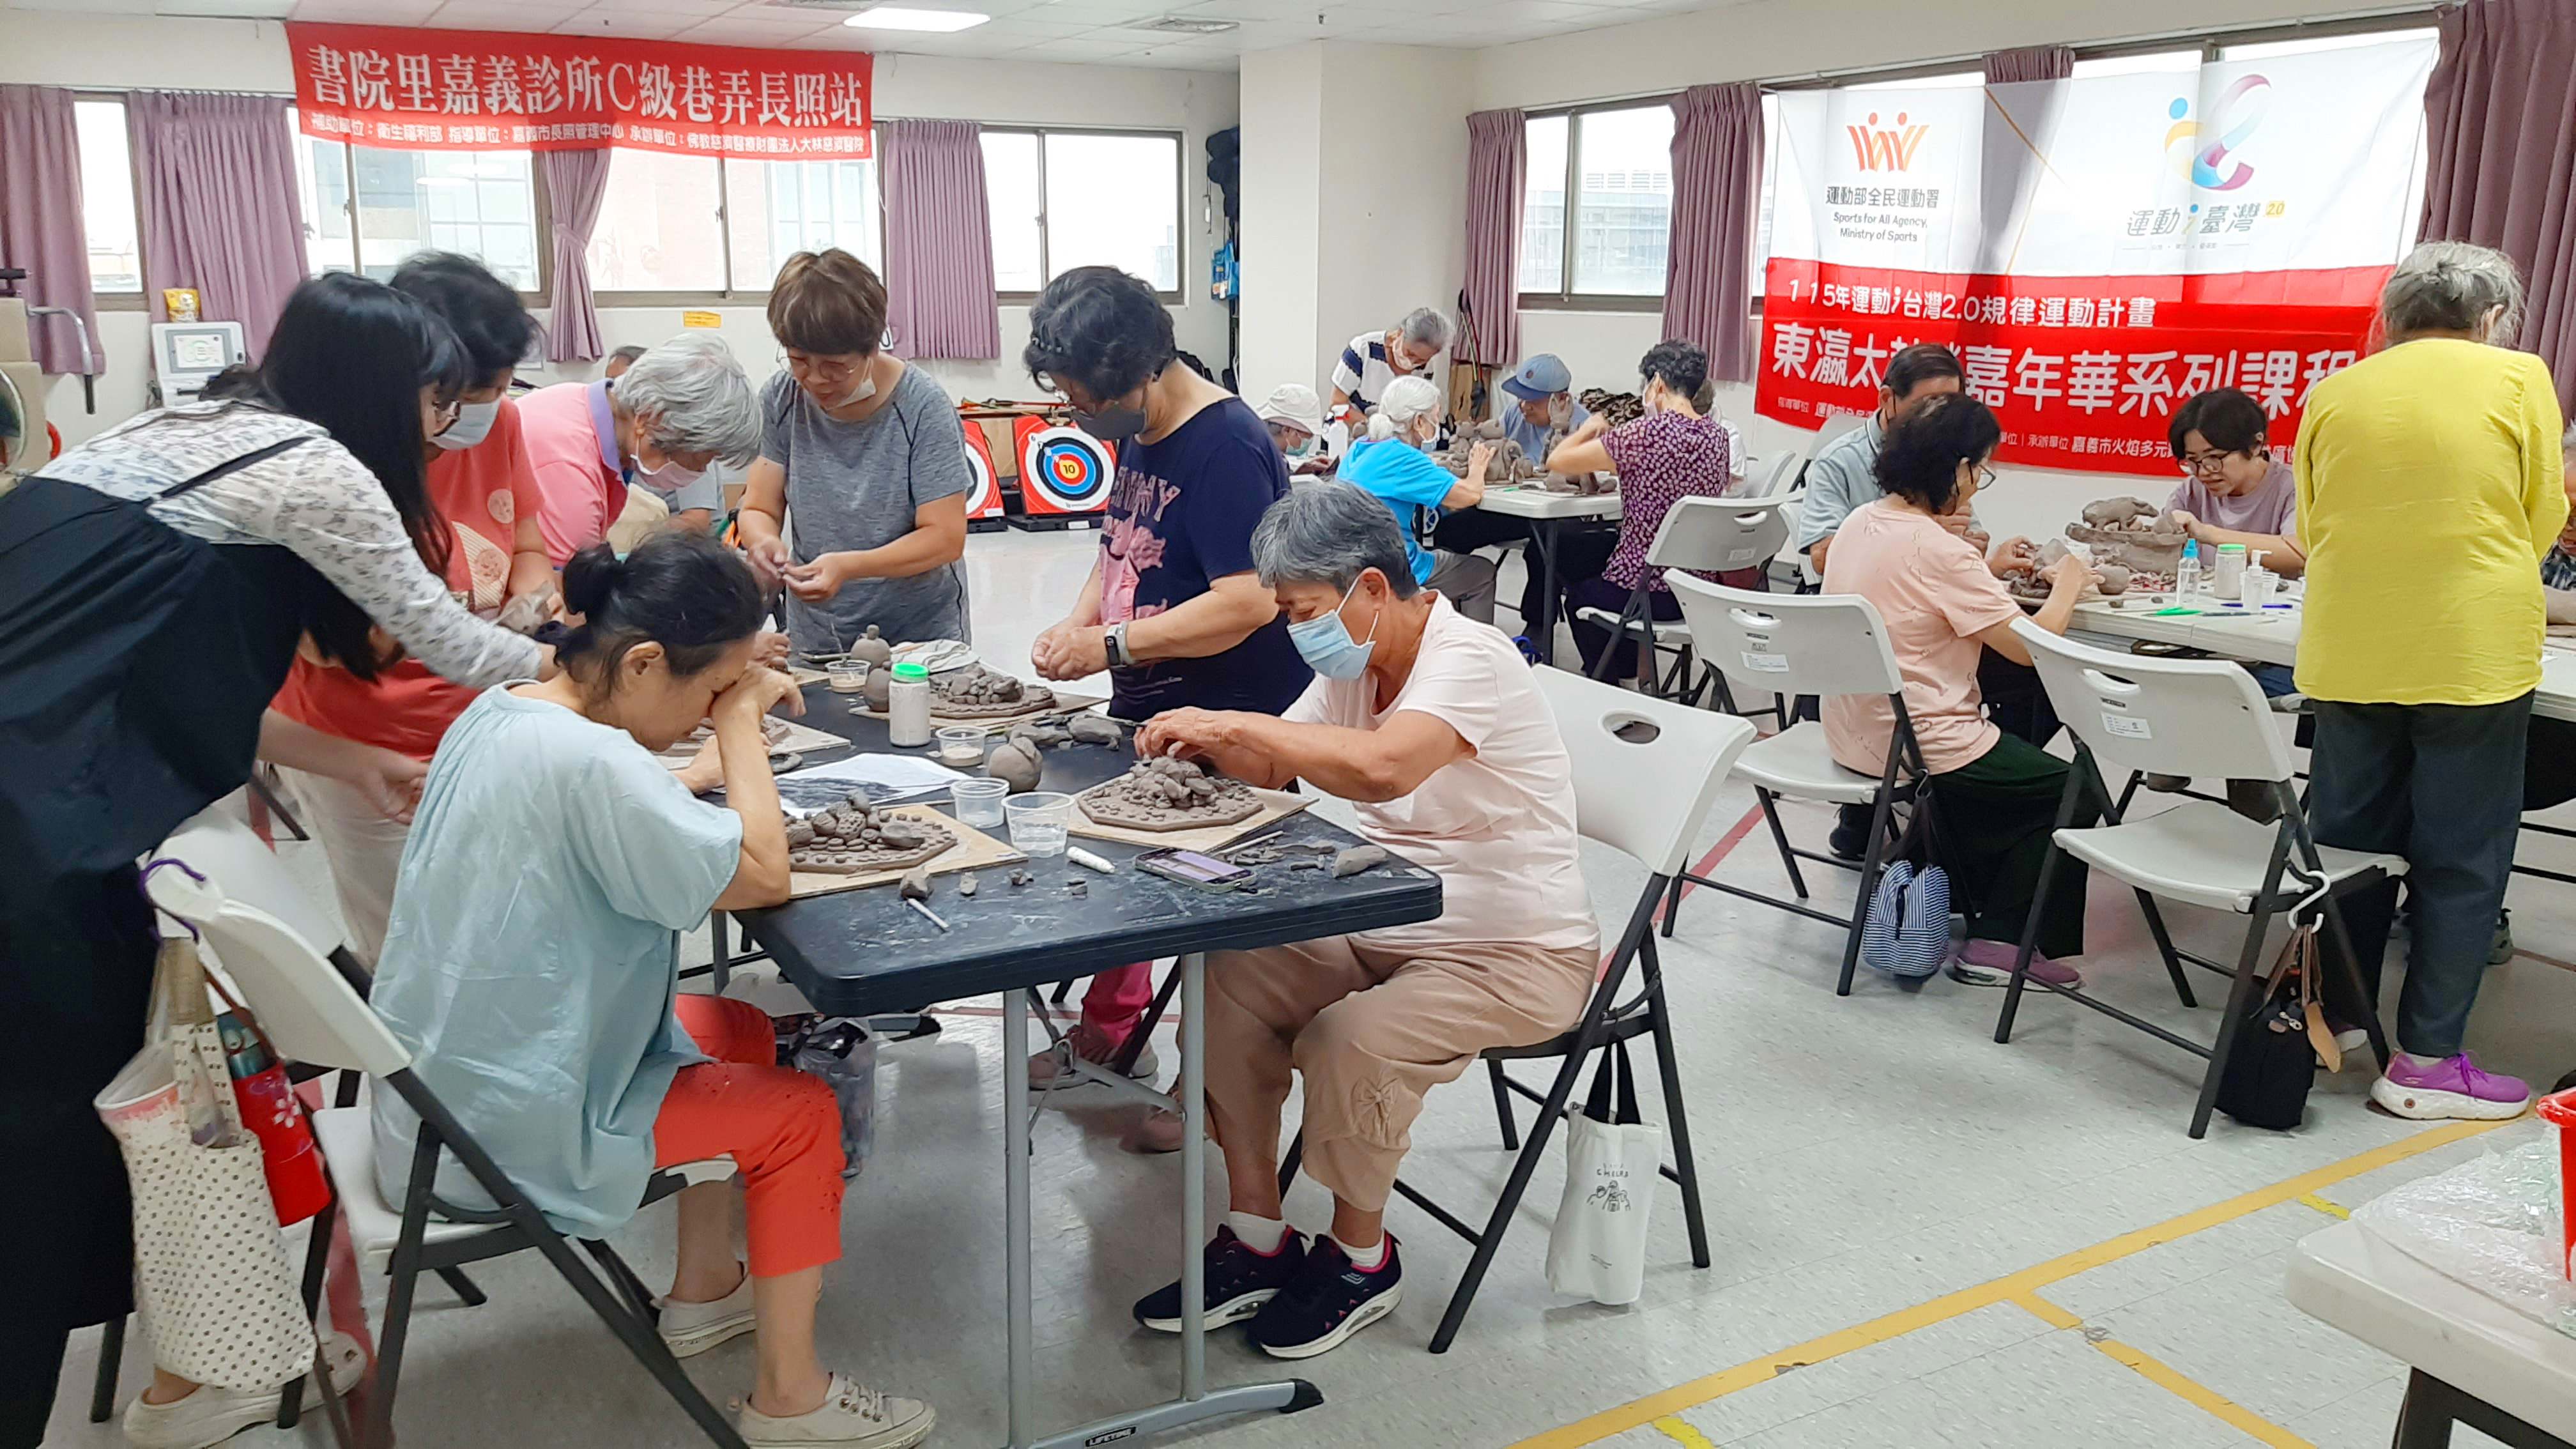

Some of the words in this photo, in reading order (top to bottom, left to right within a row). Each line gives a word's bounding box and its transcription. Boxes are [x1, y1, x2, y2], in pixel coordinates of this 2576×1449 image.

[306, 43, 862, 128] 書院里嘉義診所C級巷弄長照站
[1825, 186, 1940, 209] 運動部全民運動署
[1833, 211, 1862, 224] Sports
[1864, 213, 1876, 224] for
[1878, 214, 1890, 224] All
[1892, 215, 1928, 228] Agency,
[1839, 227, 1875, 241] Ministry
[1876, 229, 1886, 240] of
[1887, 230, 1918, 243] Sports
[2071, 436, 2175, 458] 嘉義市火焰多元
[1062, 464, 1075, 474] 10
